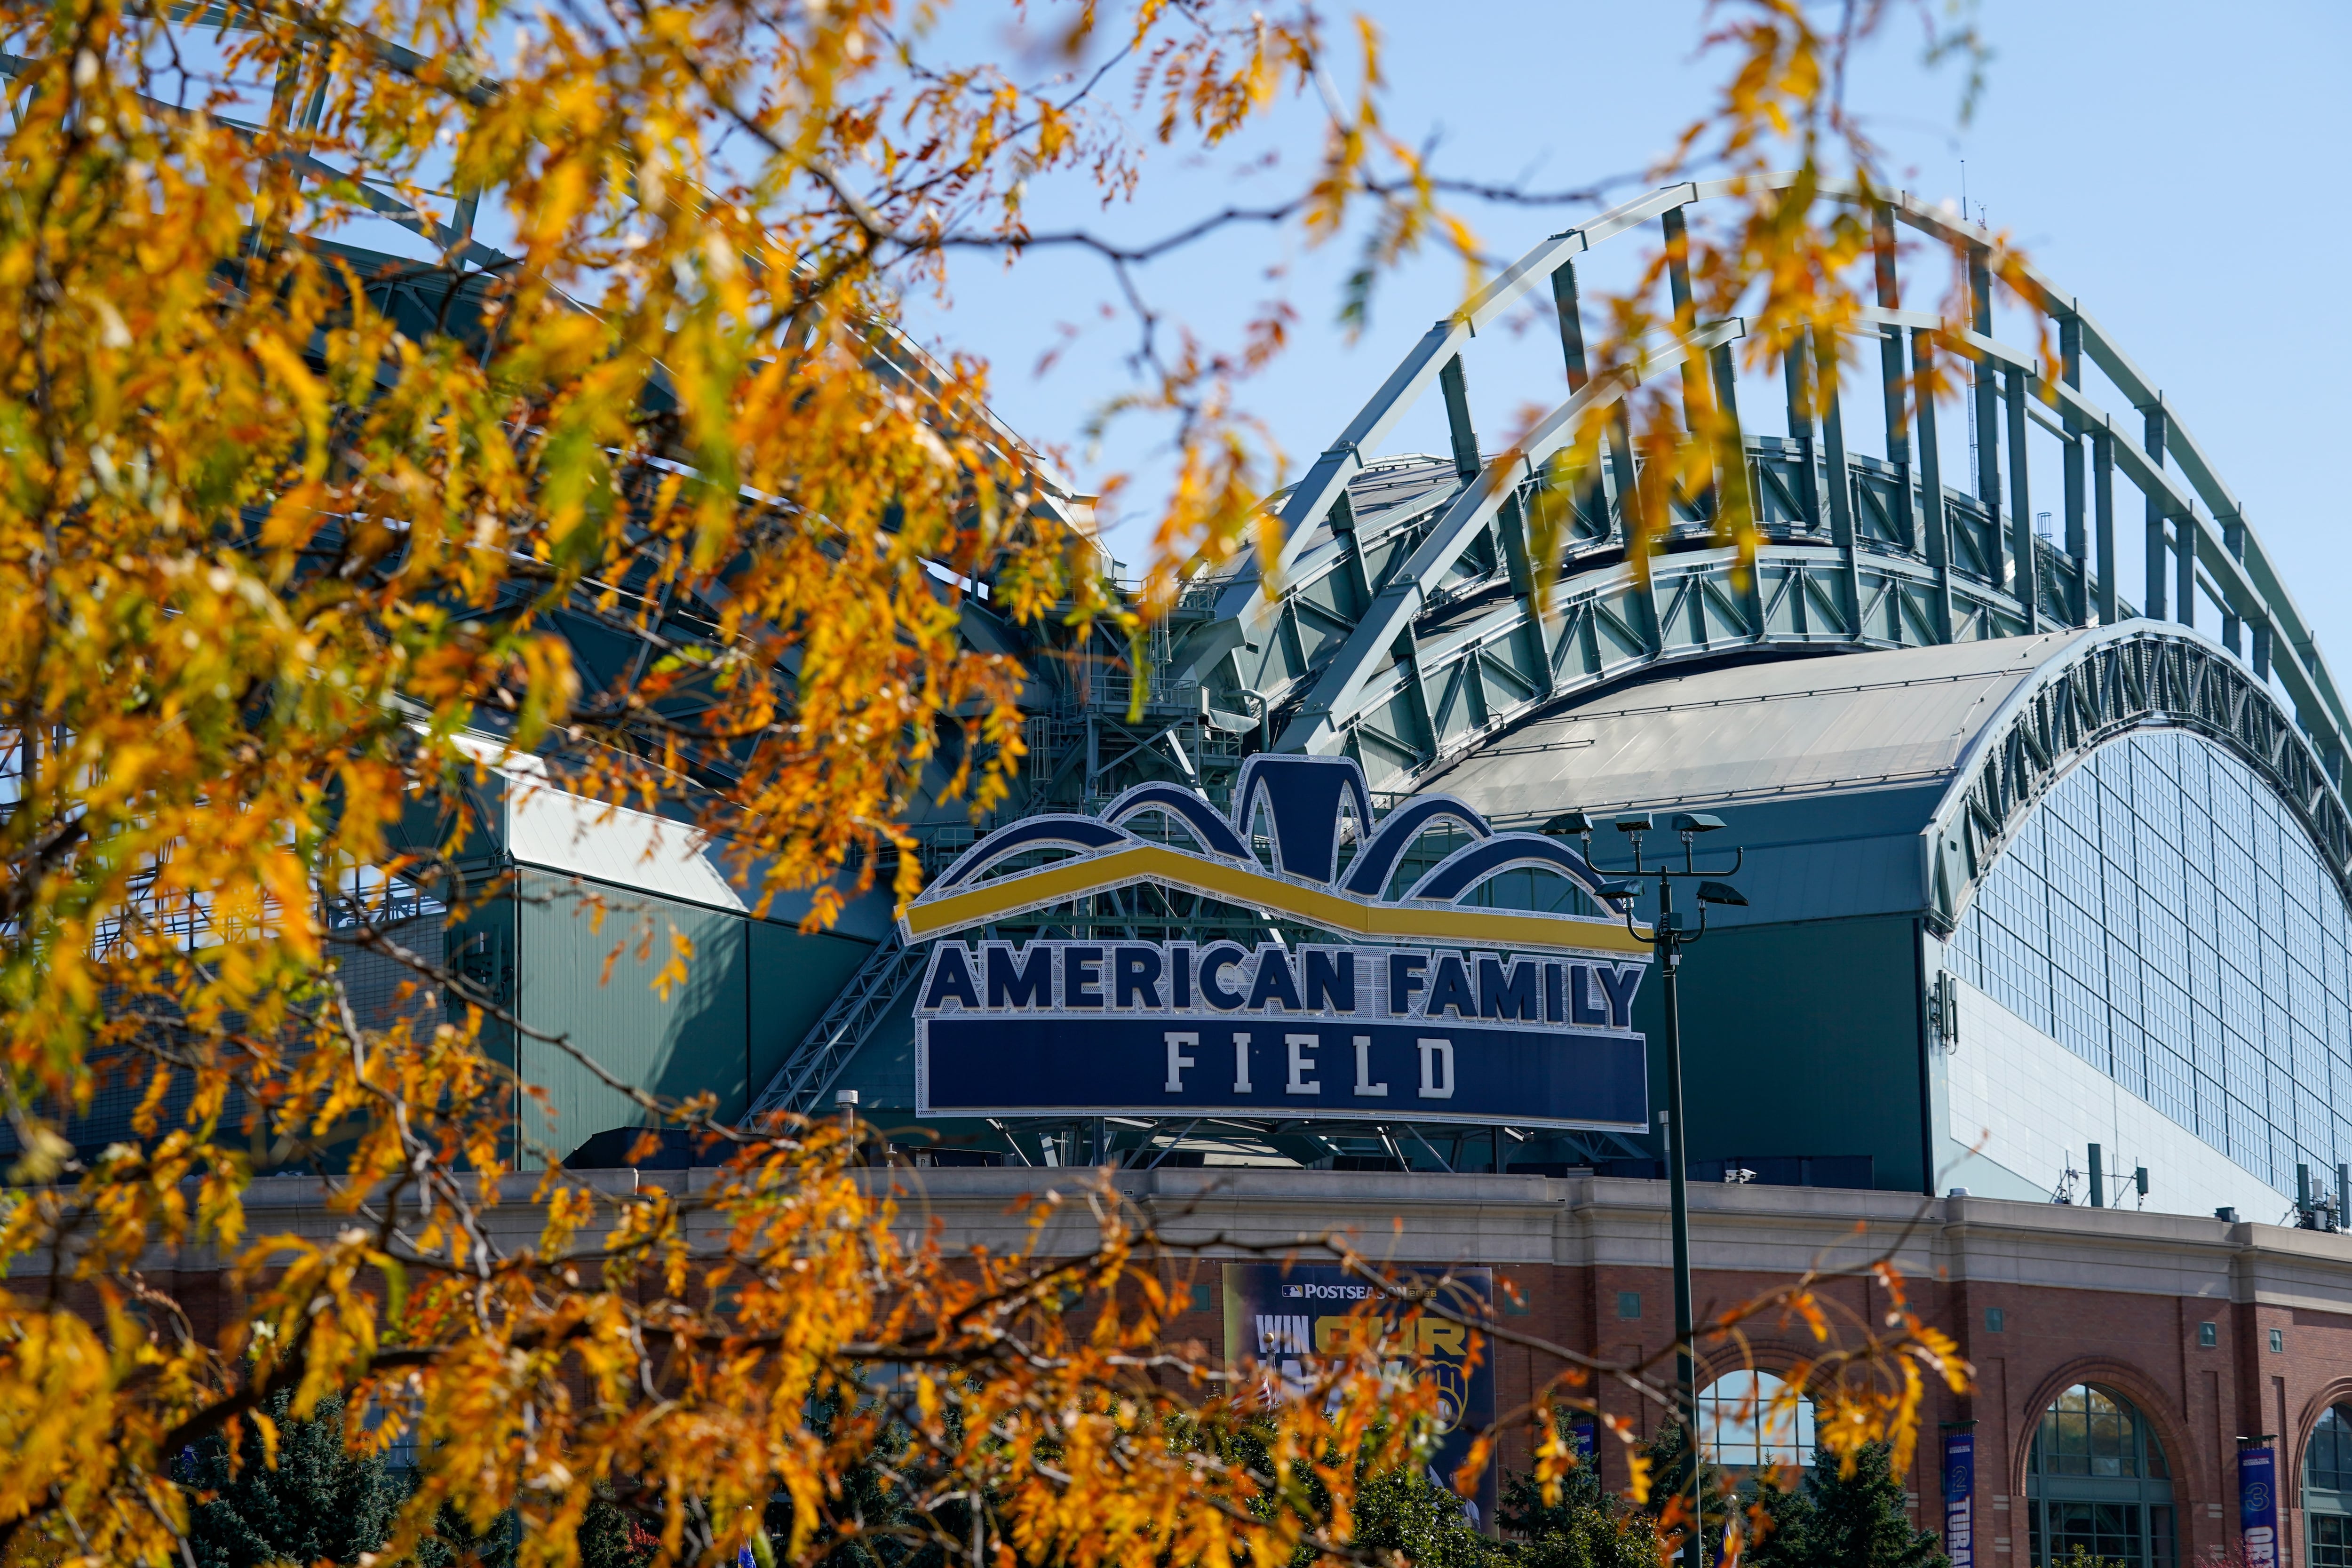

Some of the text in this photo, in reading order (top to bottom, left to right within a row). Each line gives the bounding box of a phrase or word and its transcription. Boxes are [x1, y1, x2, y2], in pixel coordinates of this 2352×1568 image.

[924, 947, 1642, 1029] AMERICAN FAMILY
[1164, 1032, 1454, 1099] FIELD
[1304, 1284, 1406, 1300] POSTSEASON
[1256, 1315, 1467, 1355] WIN OUR
[1952, 1465, 1967, 1492] 2
[2245, 1482, 2270, 1512] 3
[1948, 1495, 1971, 1568] TURA
[2244, 1526, 2275, 1568] OR
